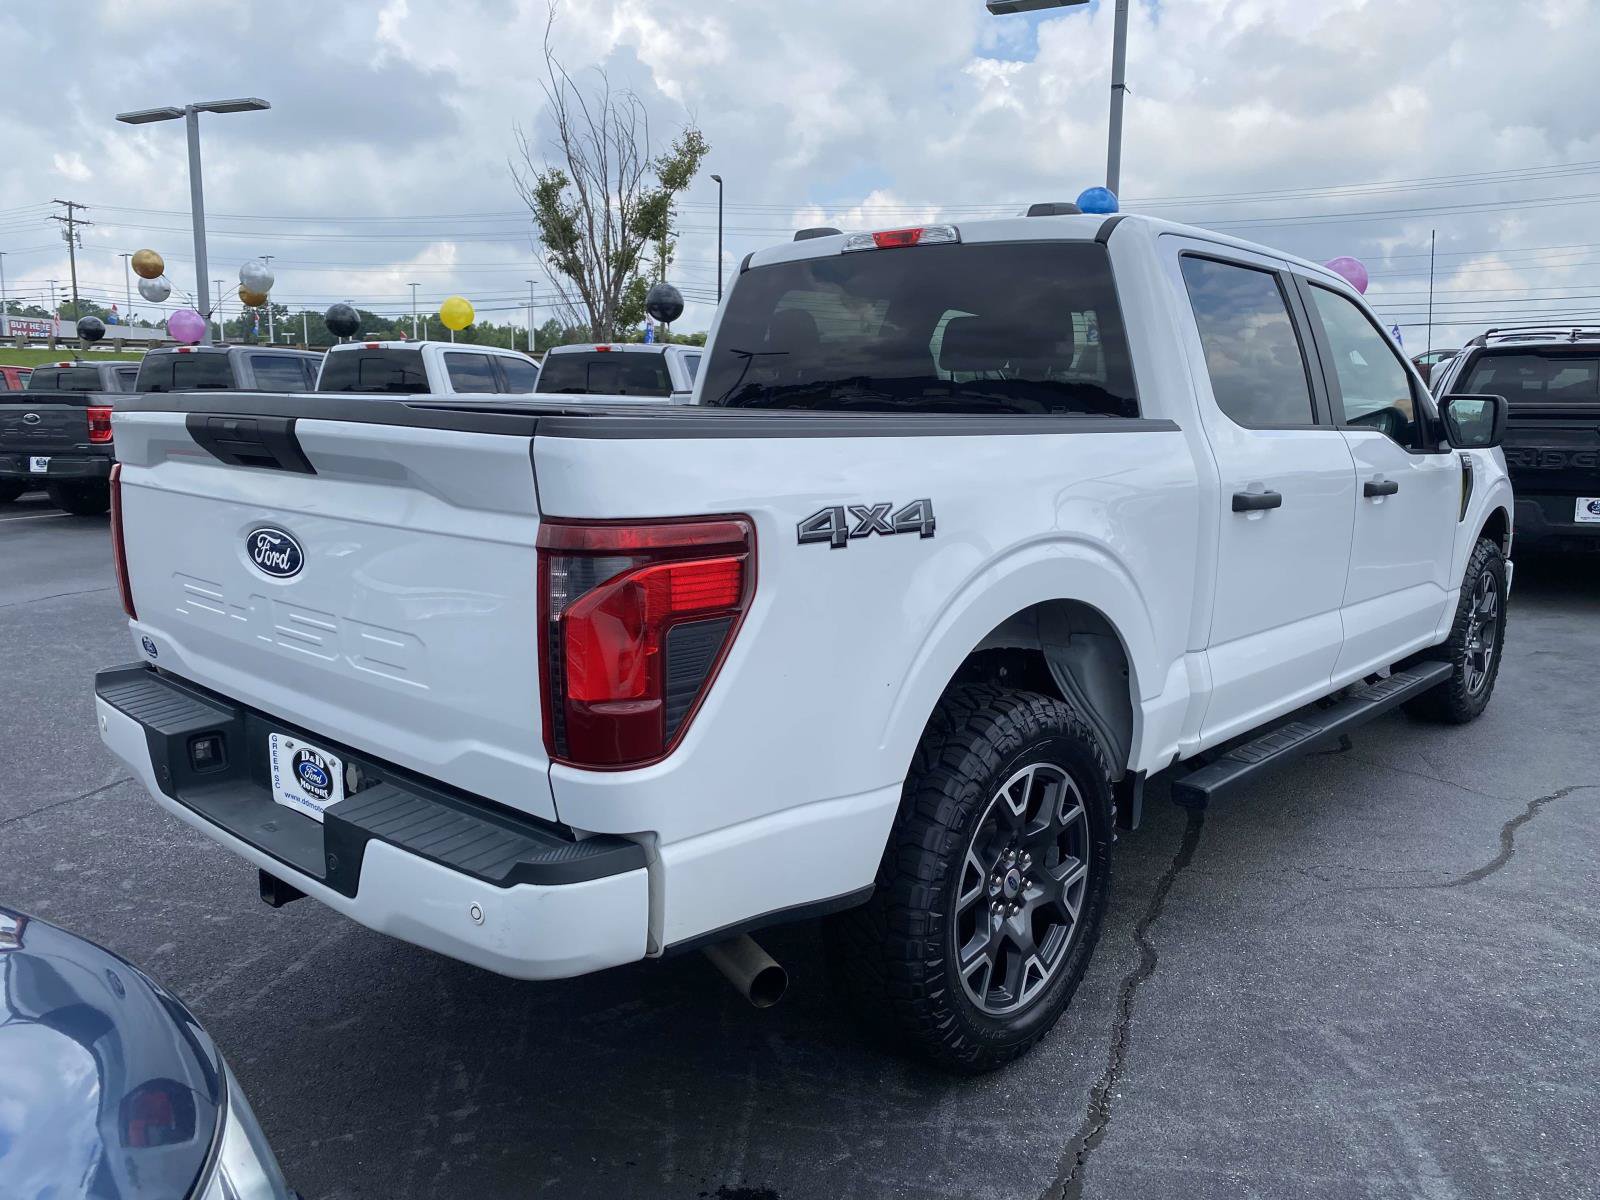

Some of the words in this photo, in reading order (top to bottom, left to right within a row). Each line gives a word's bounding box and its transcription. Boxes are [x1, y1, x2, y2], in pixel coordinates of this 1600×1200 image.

[254, 533, 291, 570] Ford
[301, 750, 325, 769] D&D
[274, 774, 281, 789] SC
[304, 764, 323, 784] Ford
